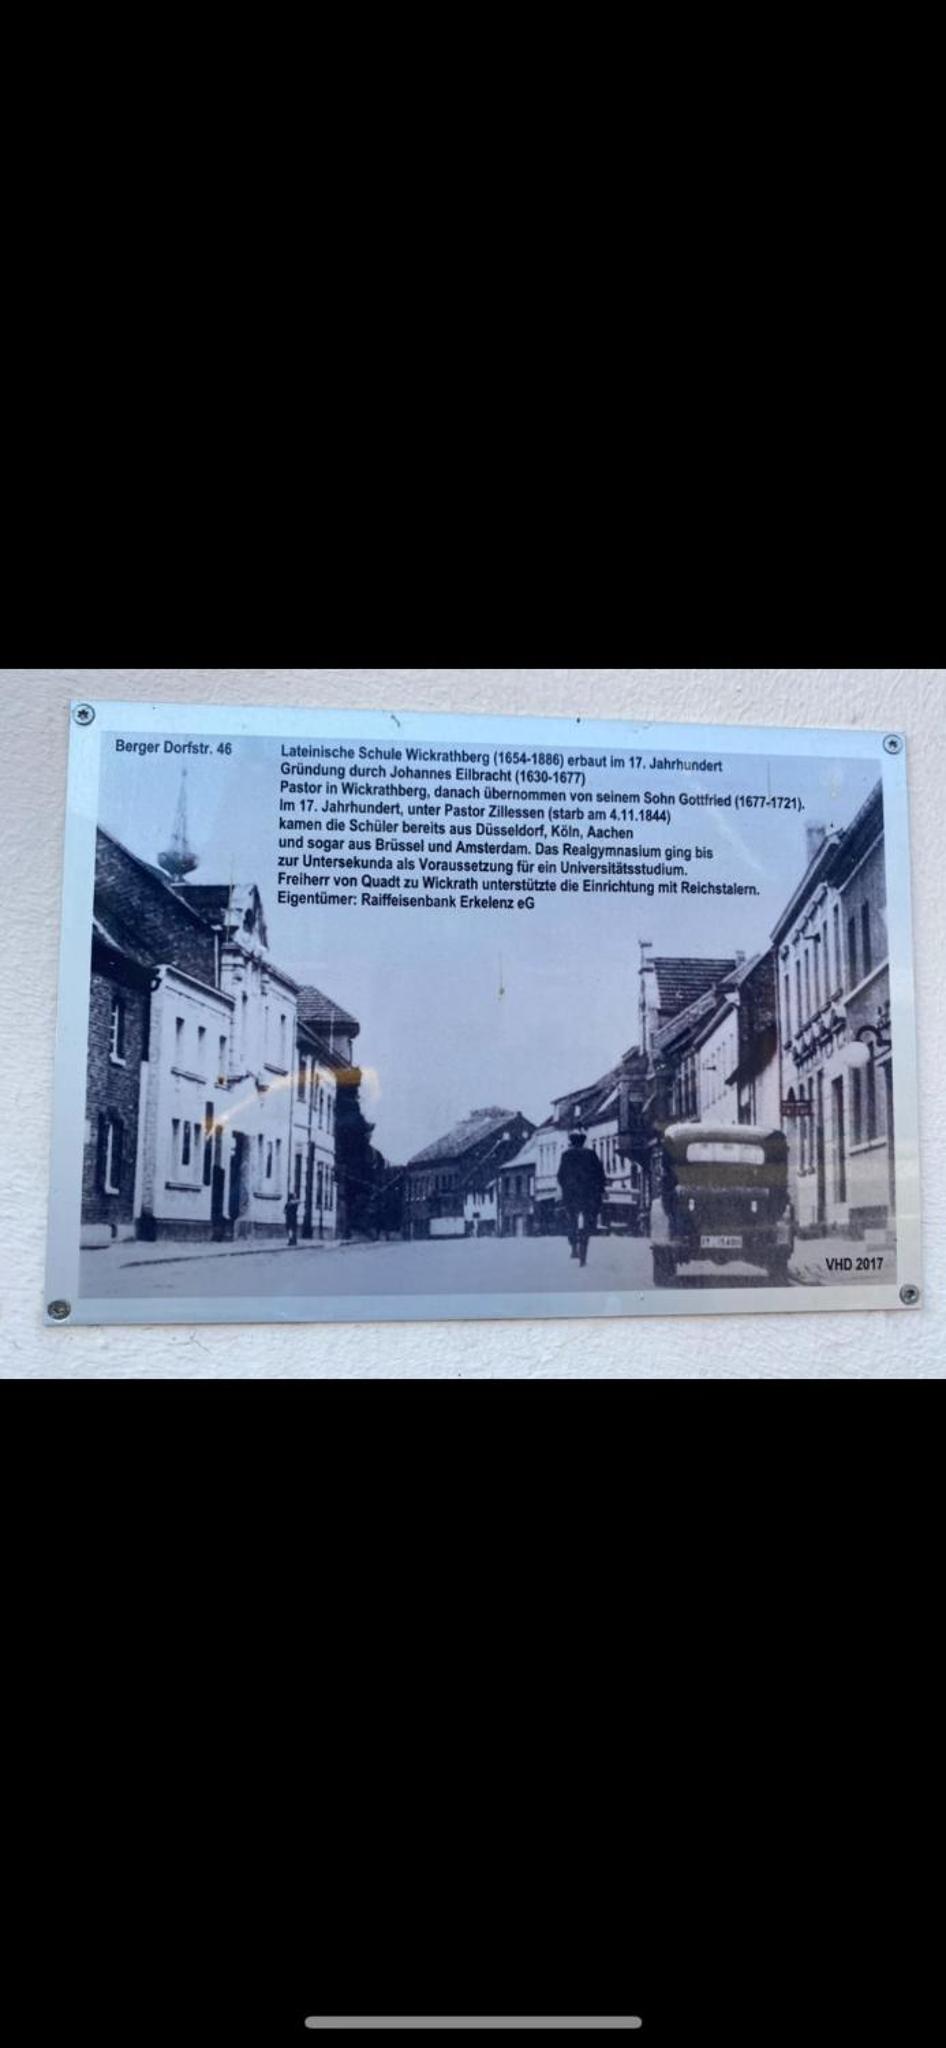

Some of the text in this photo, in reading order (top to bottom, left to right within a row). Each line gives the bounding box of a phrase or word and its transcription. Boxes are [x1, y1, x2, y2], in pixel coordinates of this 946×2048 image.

[116, 739, 232, 756] Berger Dorfstr. 46
[281, 744, 723, 772] Lateinische Schule Wickrathberg (1654-1886) erbaut im 17. Jahrhundert
[281, 762, 586, 787] Gründung durch Johannes Eilbracht (1630-1677)
[280, 780, 804, 812] Pastor in Wickrathberg, danach übernommen von seinem Sohn Gottfried (1677-1721).
[280, 798, 671, 825] Im 17. Jahrhundert, unter Pastor Zillessen (starb am 4.11.1844)
[280, 817, 633, 839] kamen die Schüler bereits aus Düsseldorf, Köln, Aachen
[279, 836, 713, 862] und sogar aus Brüssel und Amsterdam. Das Realgymnasium ging bis
[278, 854, 687, 876] zur Untersekunda als Voraussetzung für ein Universitätsstudium.
[278, 872, 760, 896] Freiherr von Quadt zu Wickrath unterstützte die Einrichtung mit Reichstalern.
[278, 891, 535, 910] Eigentümer: Raiffeisenbank Erkelenz eG
[826, 1257, 884, 1271] VHD 2017
